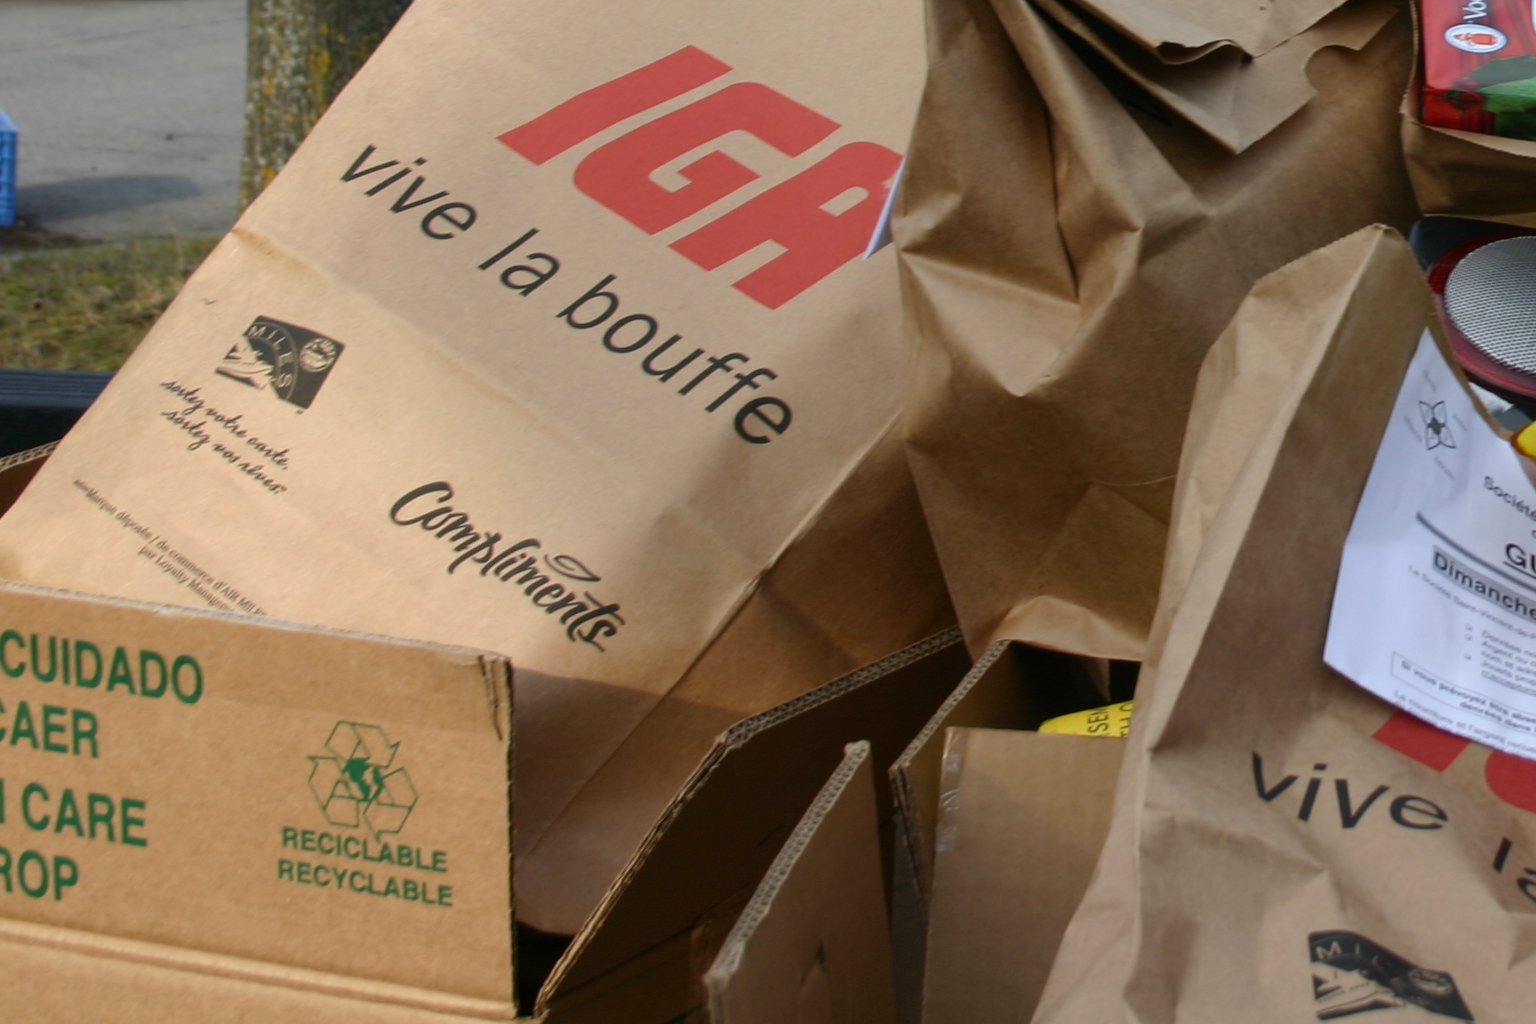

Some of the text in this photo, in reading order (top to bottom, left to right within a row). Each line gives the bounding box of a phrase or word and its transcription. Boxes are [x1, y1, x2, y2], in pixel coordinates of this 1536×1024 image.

[496, 44, 905, 311] IGA
[340, 144, 794, 445] vive la bouffe
[388, 479, 627, 654] Compliments
[0, 628, 205, 705] CUIDADO
[0, 700, 100, 758] AER
[20, 782, 149, 848] CARE
[1251, 752, 1450, 833] vive
[277, 859, 454, 907] RECYCLABLE
[281, 826, 449, 874] RECICLABLE
